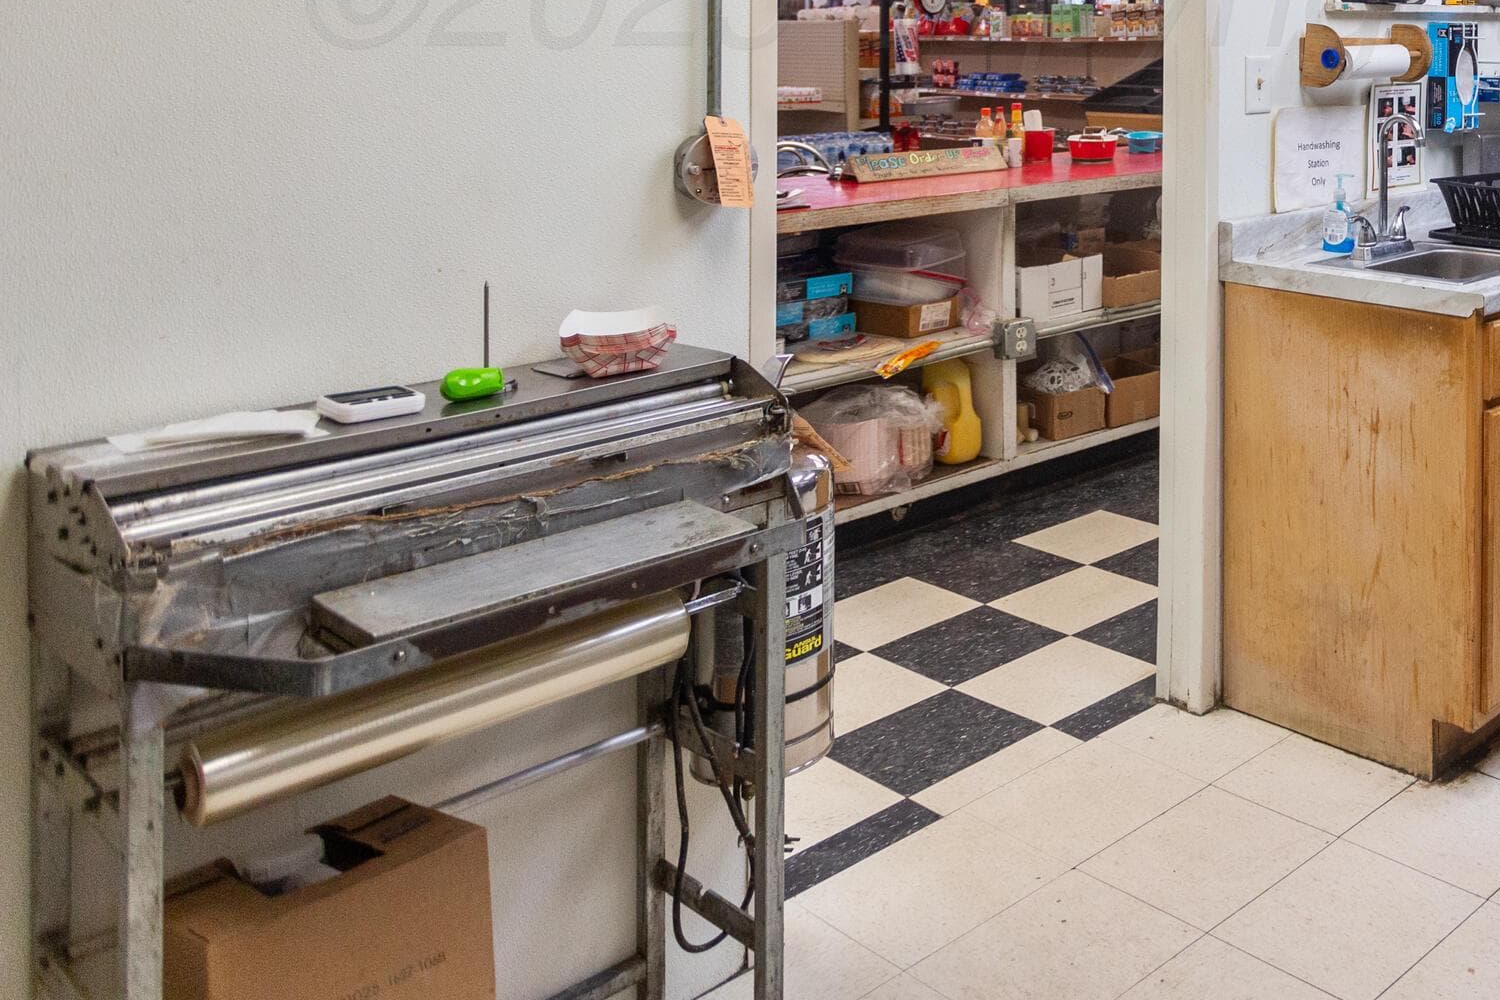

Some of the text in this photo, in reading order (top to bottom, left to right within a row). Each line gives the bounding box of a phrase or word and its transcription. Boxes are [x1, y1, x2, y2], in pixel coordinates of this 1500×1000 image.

[1297, 140, 1341, 151] Handwashing
[1308, 159, 1329, 168] Station
[1312, 177, 1326, 187] Only
